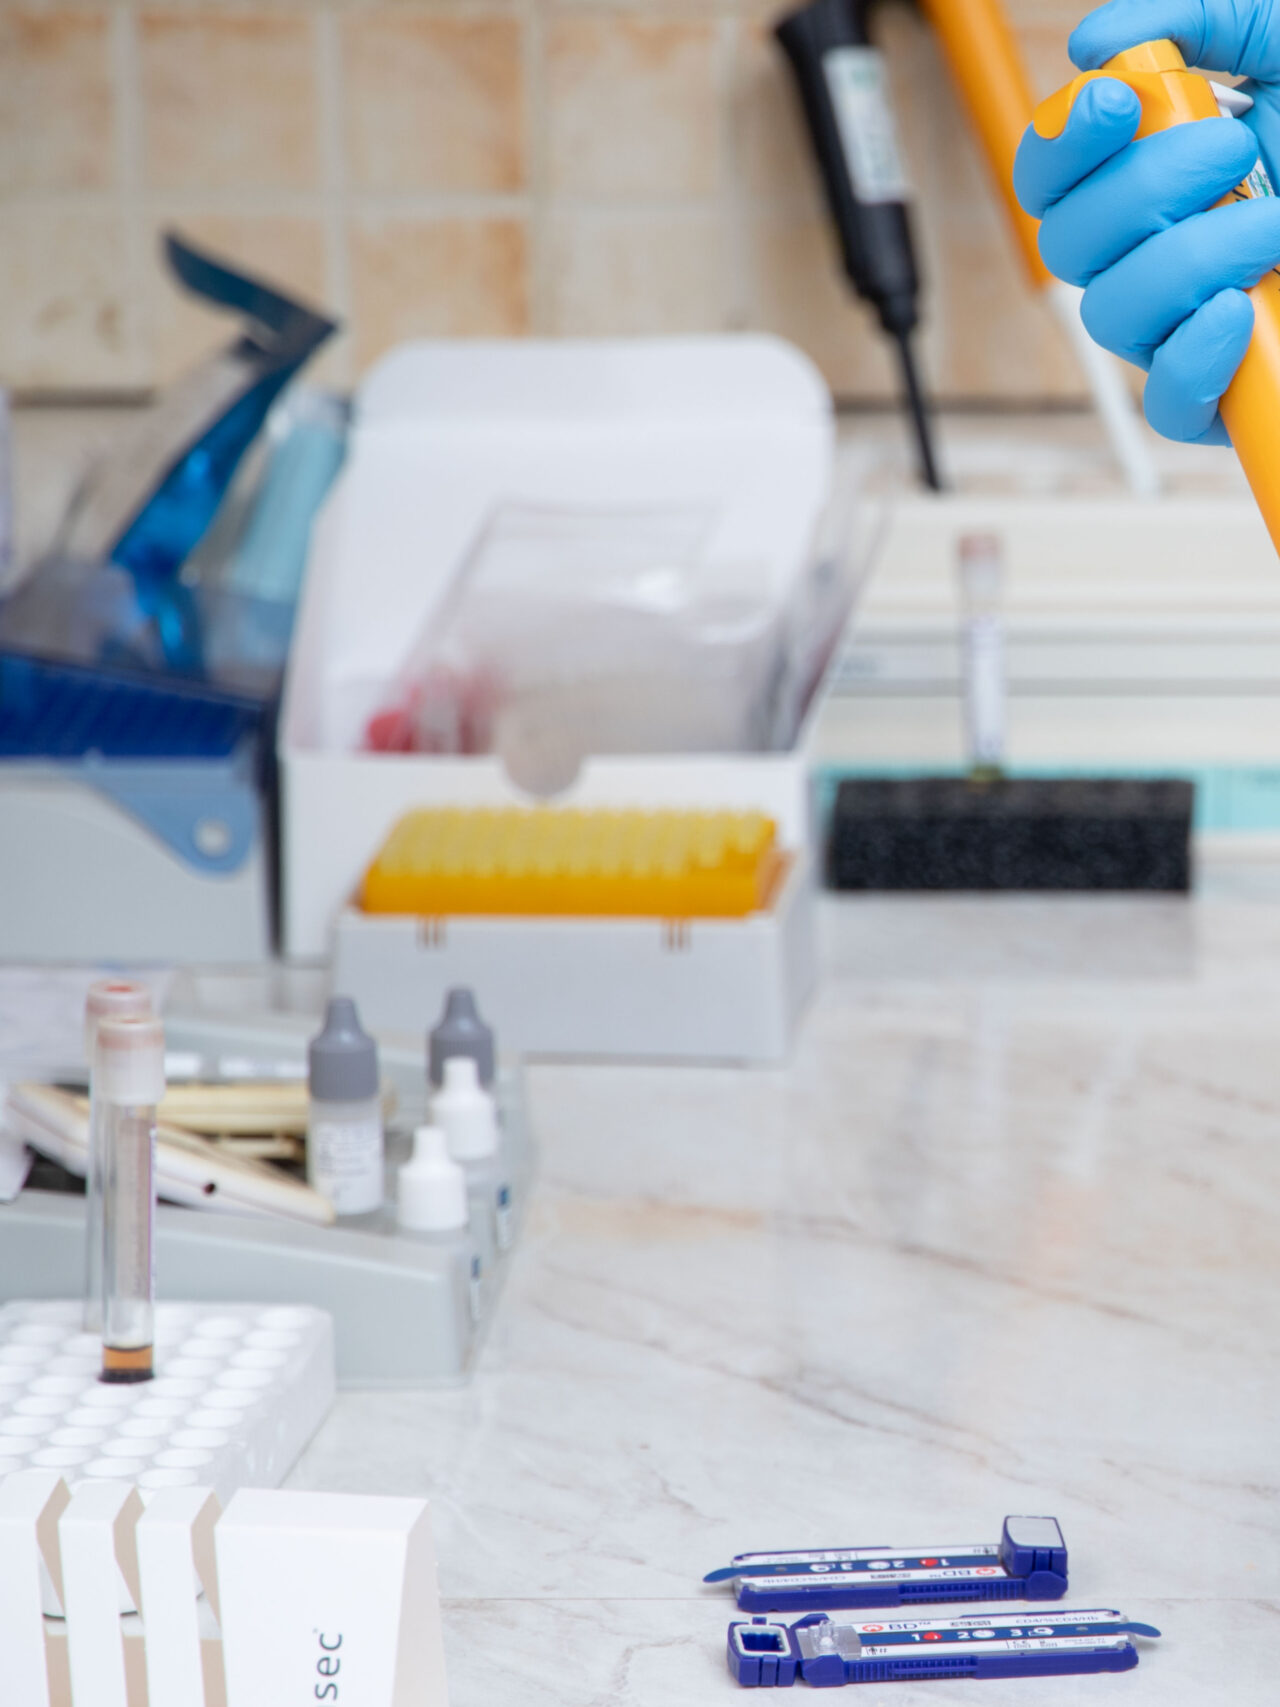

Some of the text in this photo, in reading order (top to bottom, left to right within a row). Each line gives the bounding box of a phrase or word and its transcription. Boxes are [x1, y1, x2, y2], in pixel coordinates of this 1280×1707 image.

[911, 1628, 1023, 1642] 1 2 3
